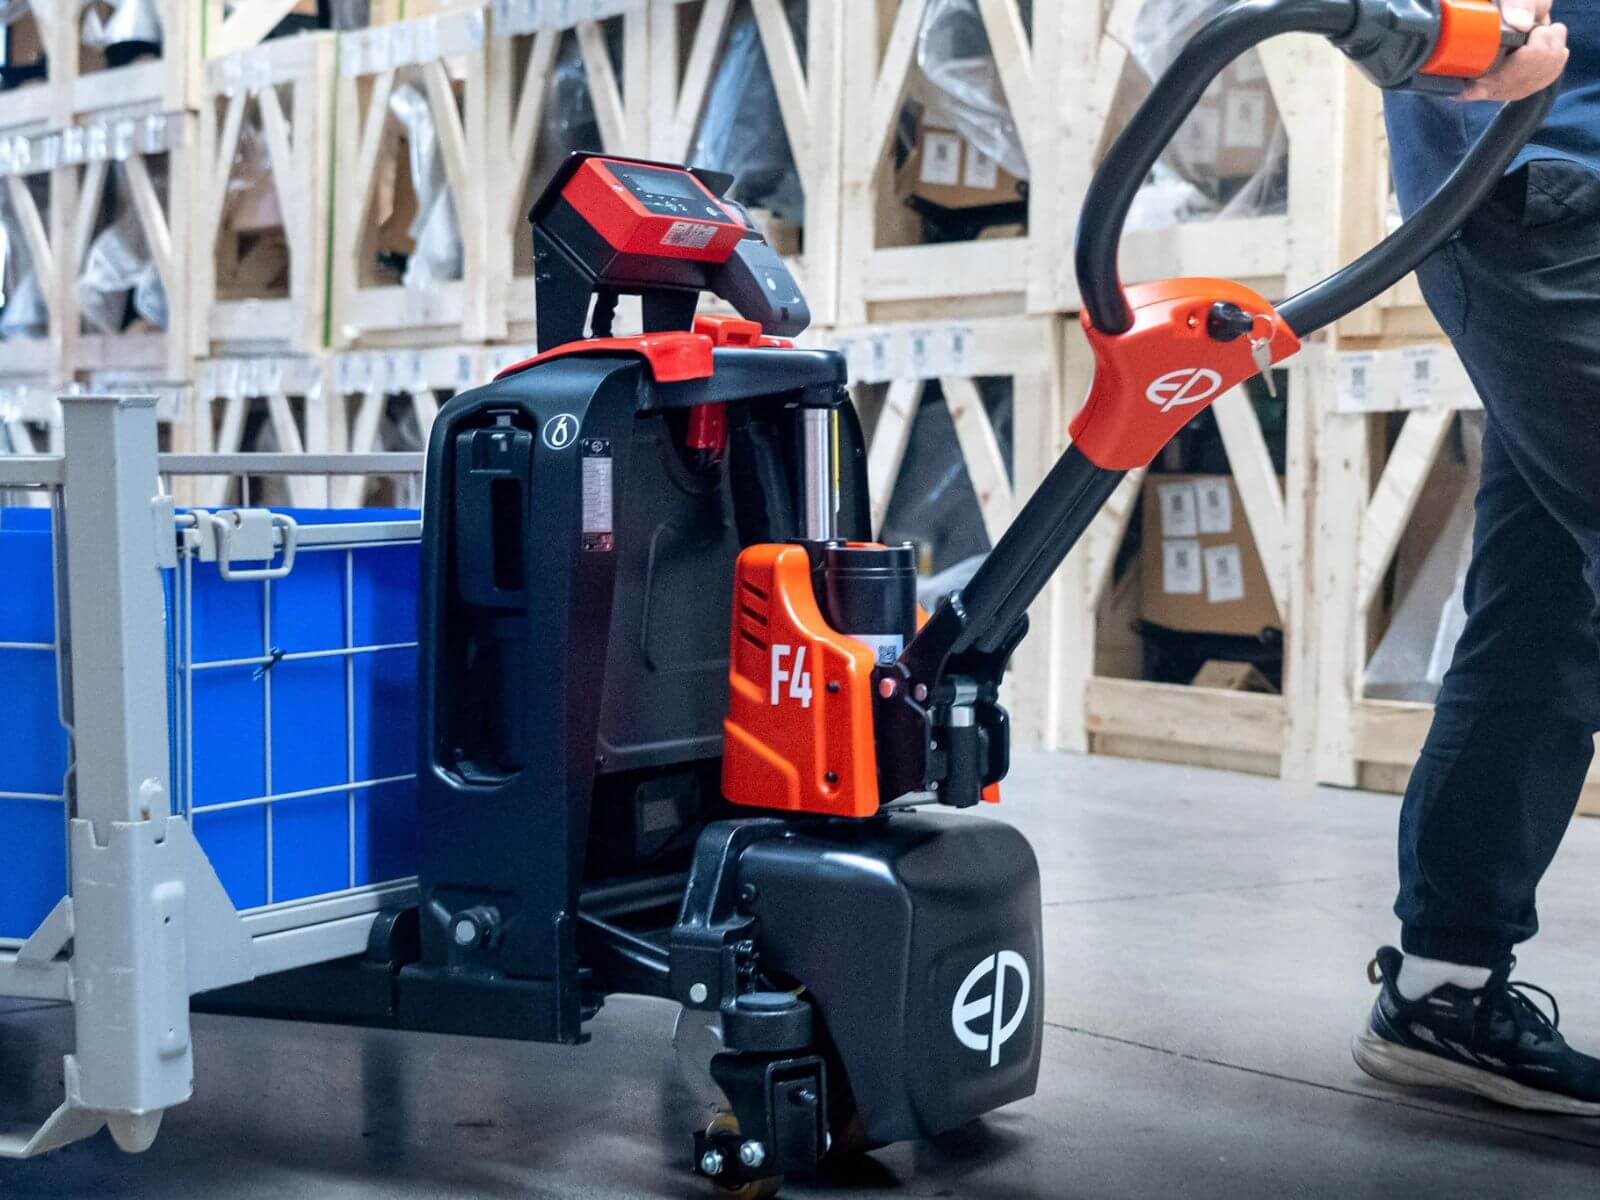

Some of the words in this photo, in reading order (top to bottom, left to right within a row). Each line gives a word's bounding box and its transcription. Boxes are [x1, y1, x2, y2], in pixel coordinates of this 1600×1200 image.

[1146, 367, 1222, 413] EP
[770, 644, 813, 708] F4
[952, 950, 1030, 1067] EP
